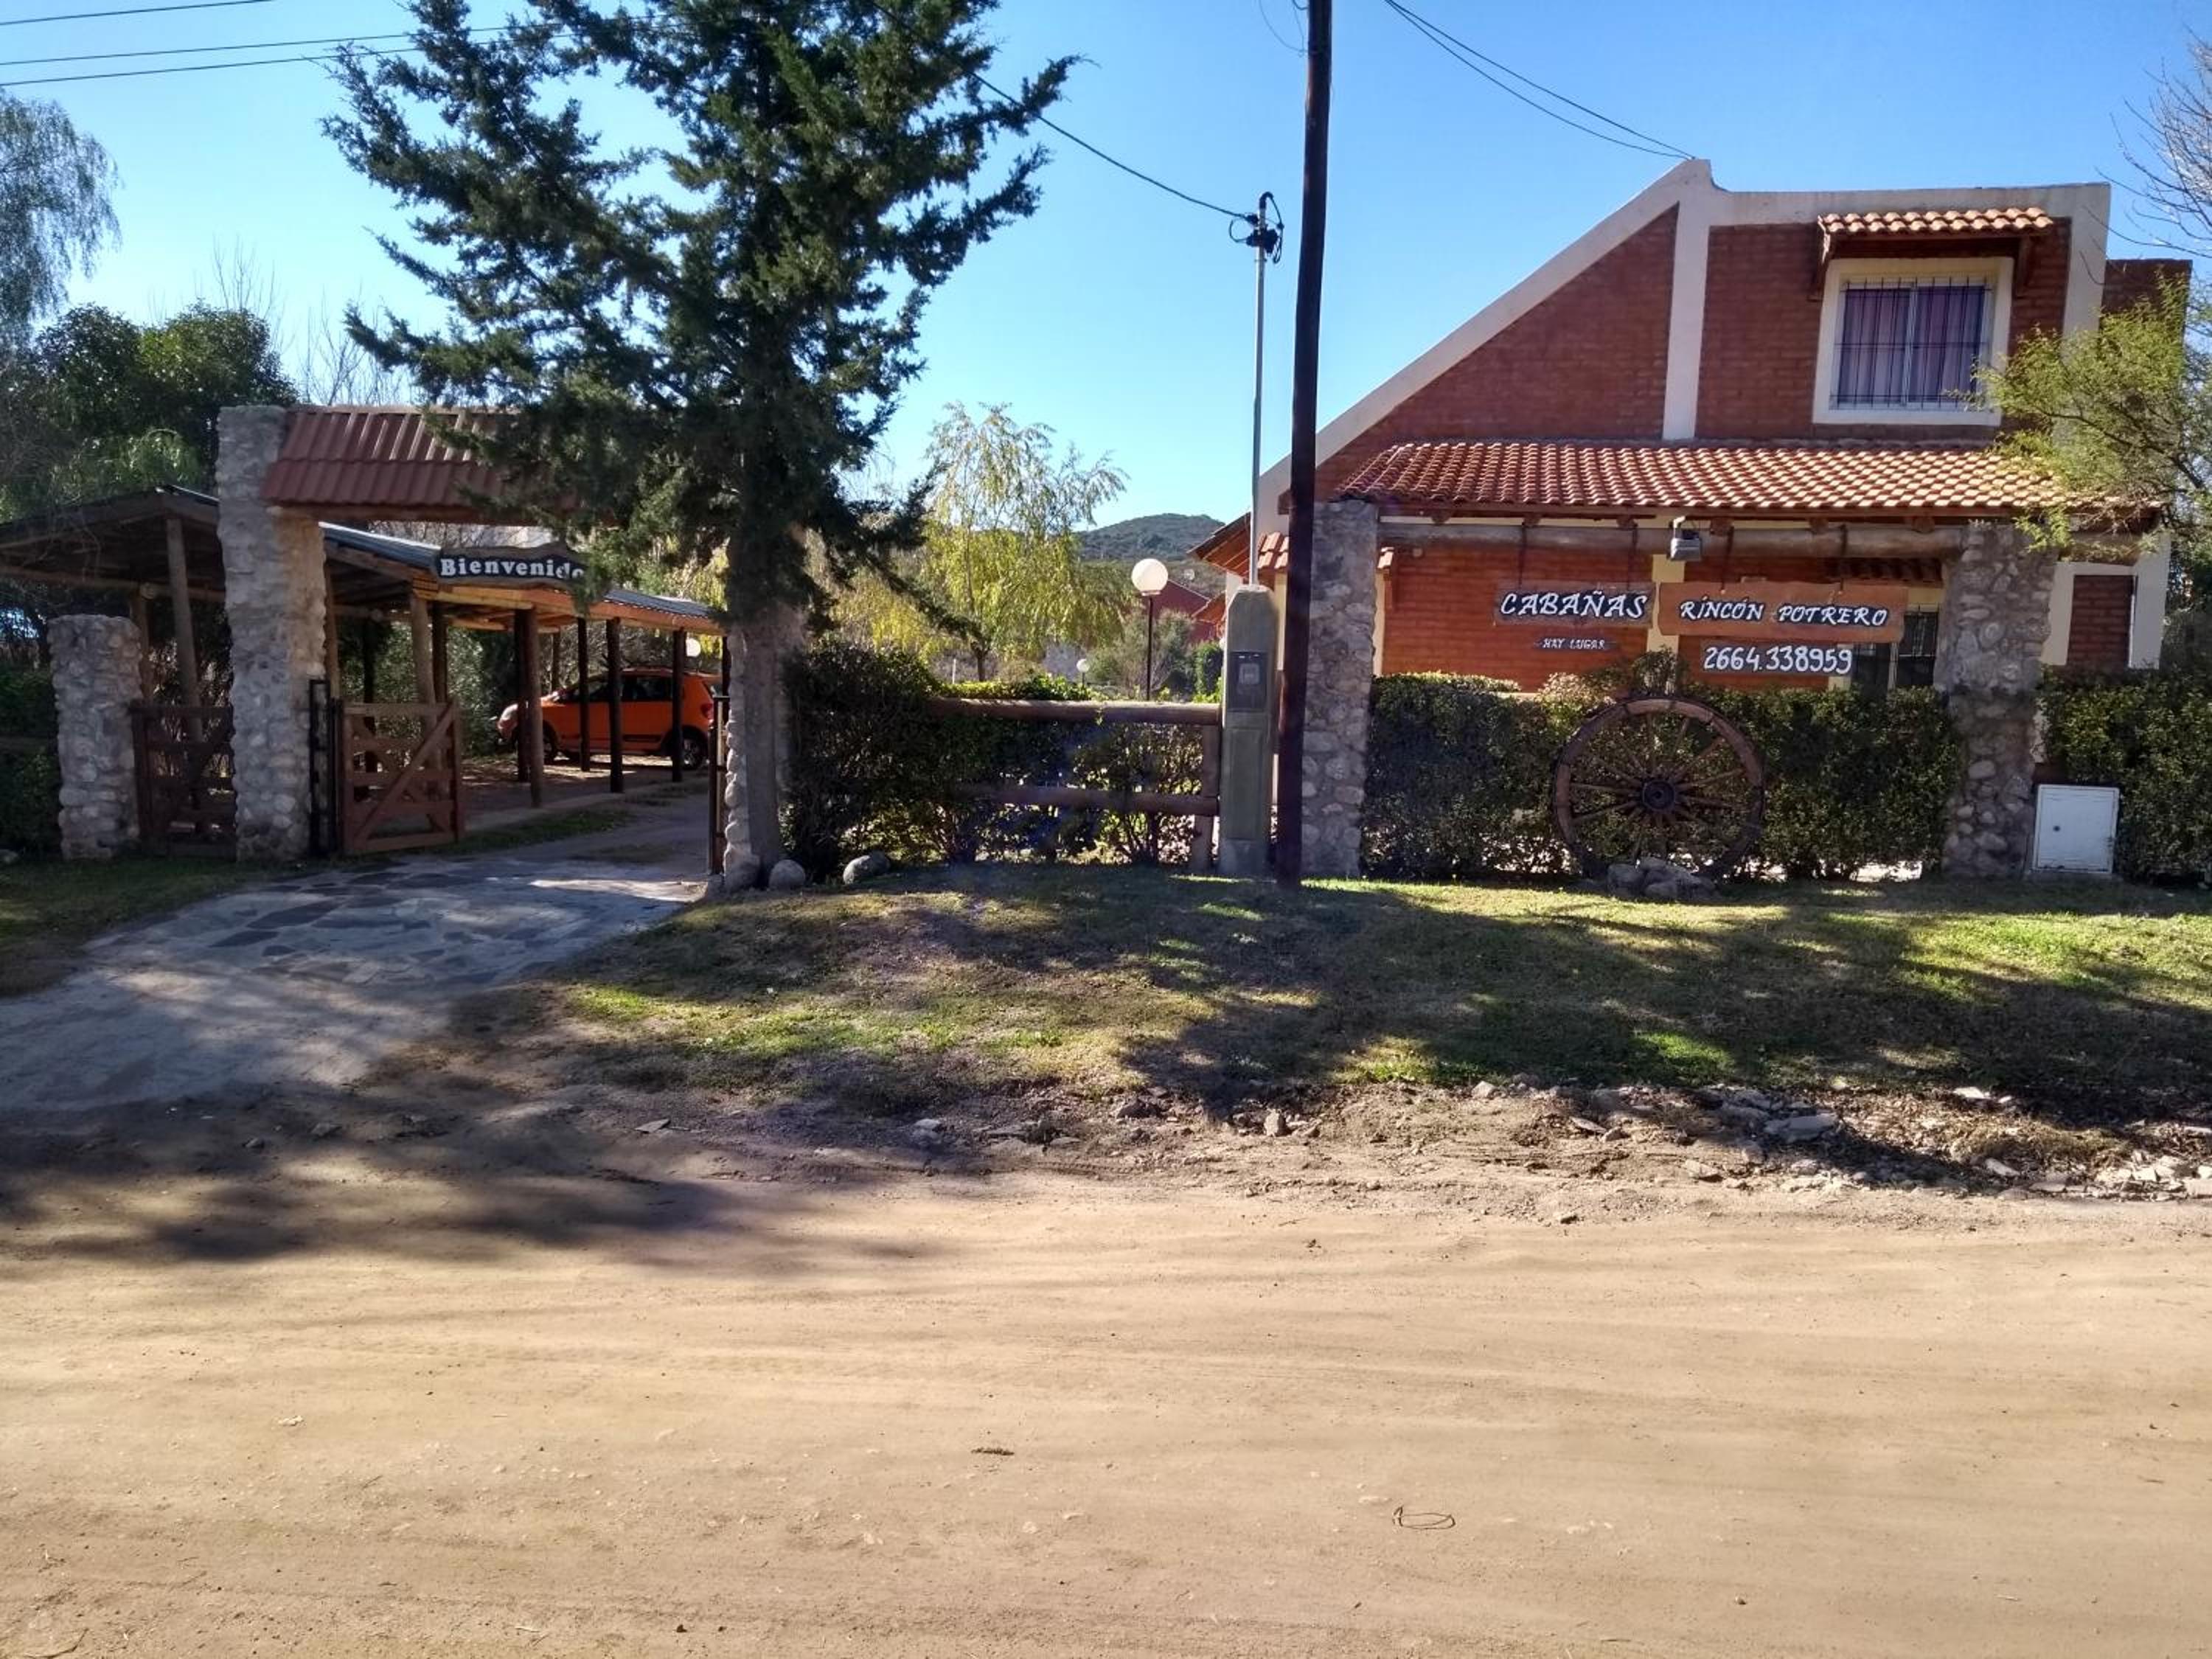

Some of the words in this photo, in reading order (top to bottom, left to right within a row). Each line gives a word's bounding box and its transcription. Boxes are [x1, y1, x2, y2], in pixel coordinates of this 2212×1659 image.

[1500, 590, 1648, 619] CABAÑAS
[1778, 605, 1888, 626] POTRERO
[1543, 638, 1565, 649] HAY
[1569, 639, 1605, 650] LUGAR
